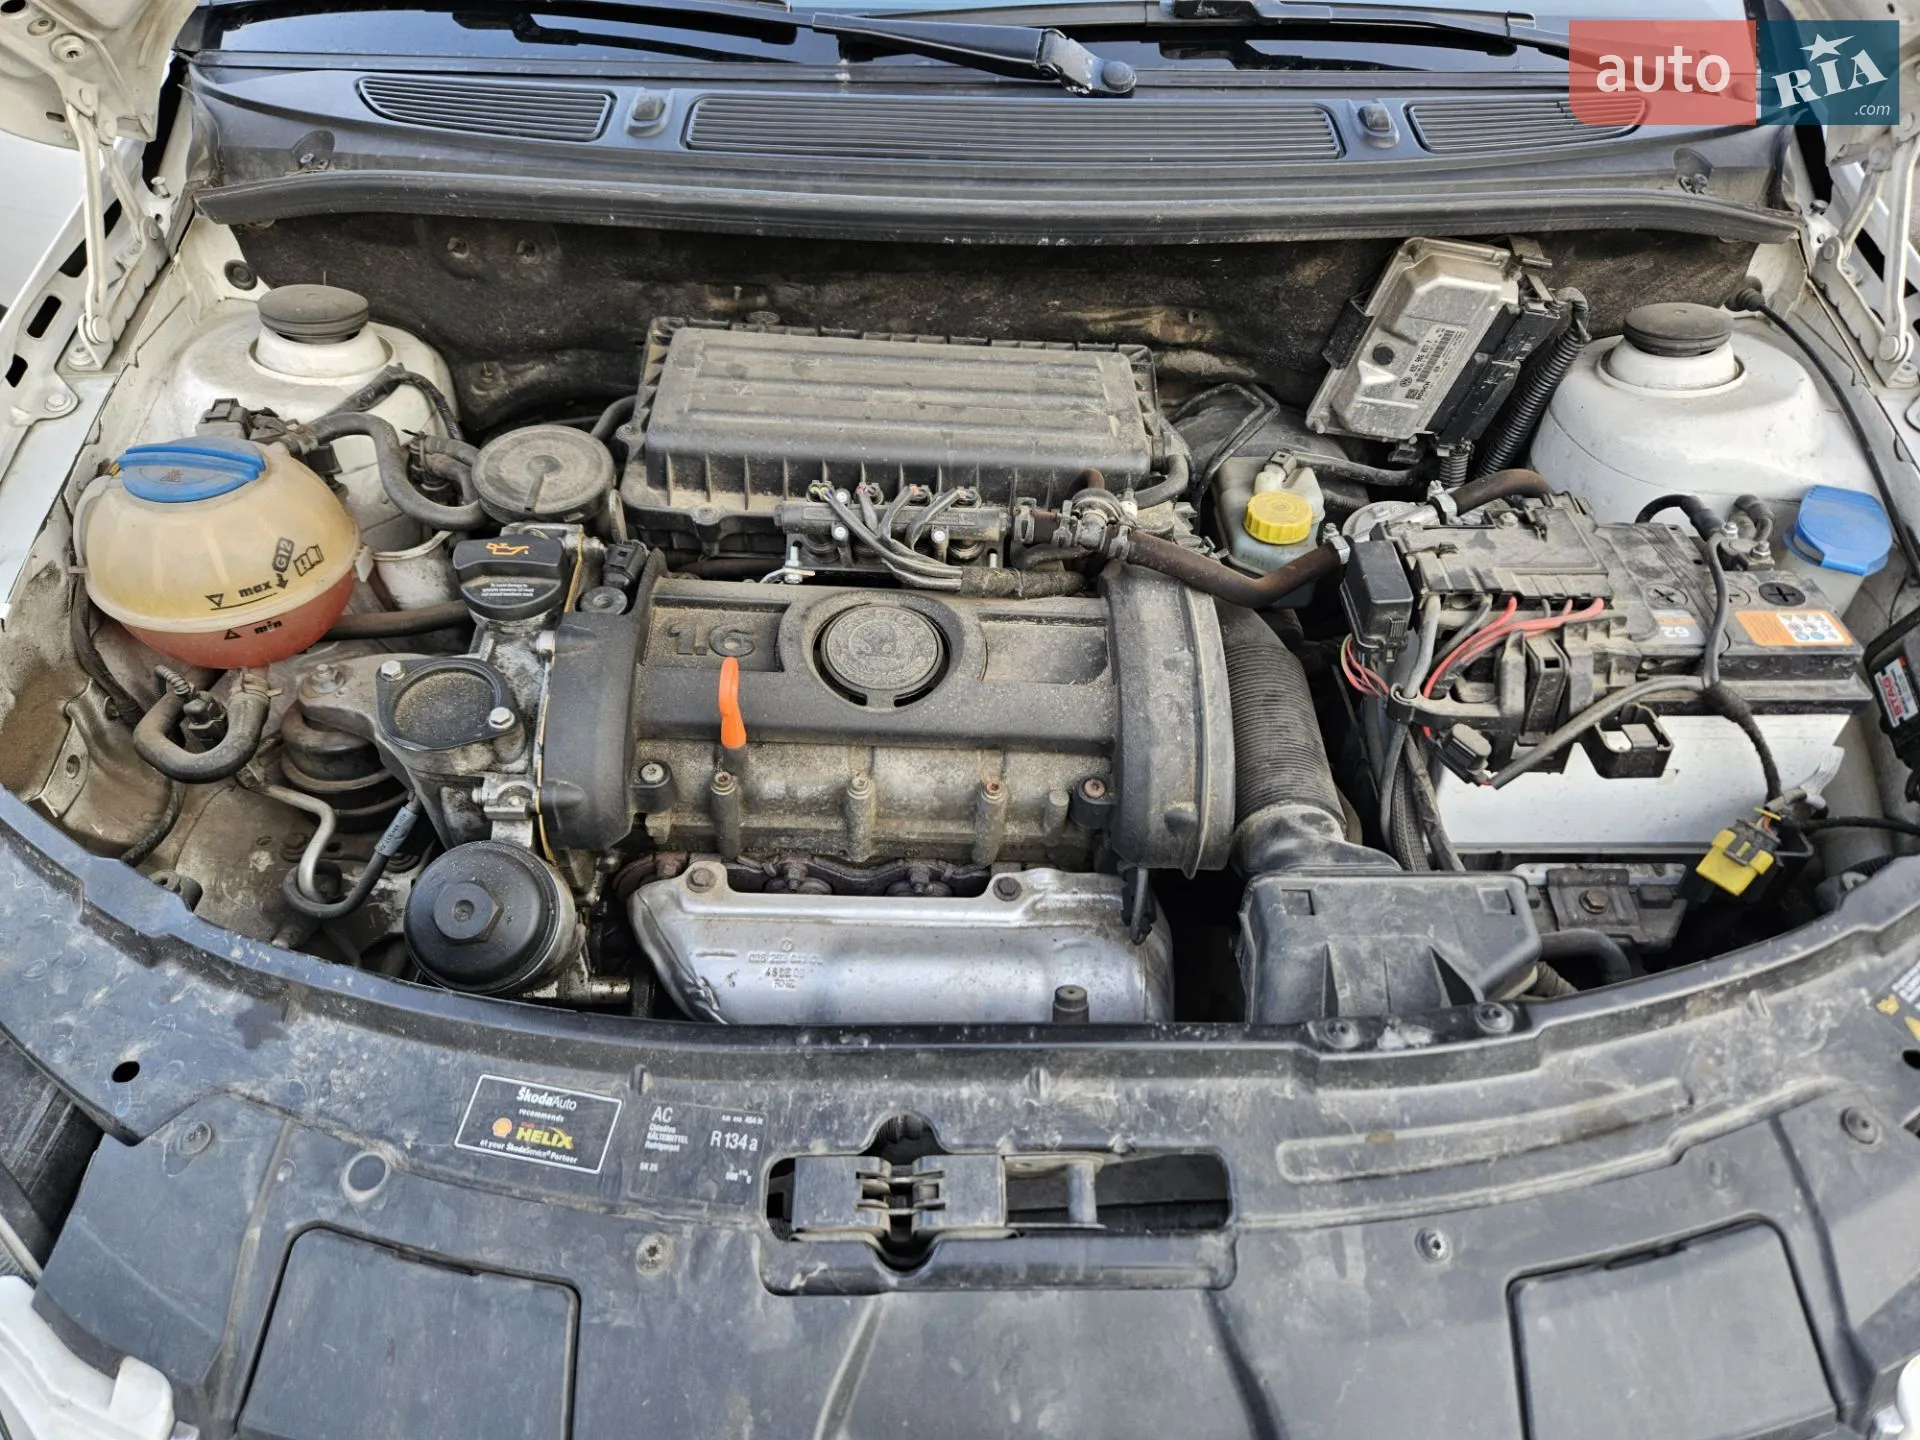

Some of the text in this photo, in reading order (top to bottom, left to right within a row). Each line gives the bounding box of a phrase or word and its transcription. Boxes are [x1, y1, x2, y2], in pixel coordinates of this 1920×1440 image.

[275, 539, 293, 570] G12
[238, 581, 273, 598] max
[254, 620, 283, 635] min
[667, 622, 757, 657] 1.6
[518, 1108, 565, 1123] recommends
[651, 1106, 674, 1123] AC
[515, 1126, 574, 1150] HELIX
[710, 1130, 759, 1152] R 134 a
[550, 1150, 578, 1164] Partner
